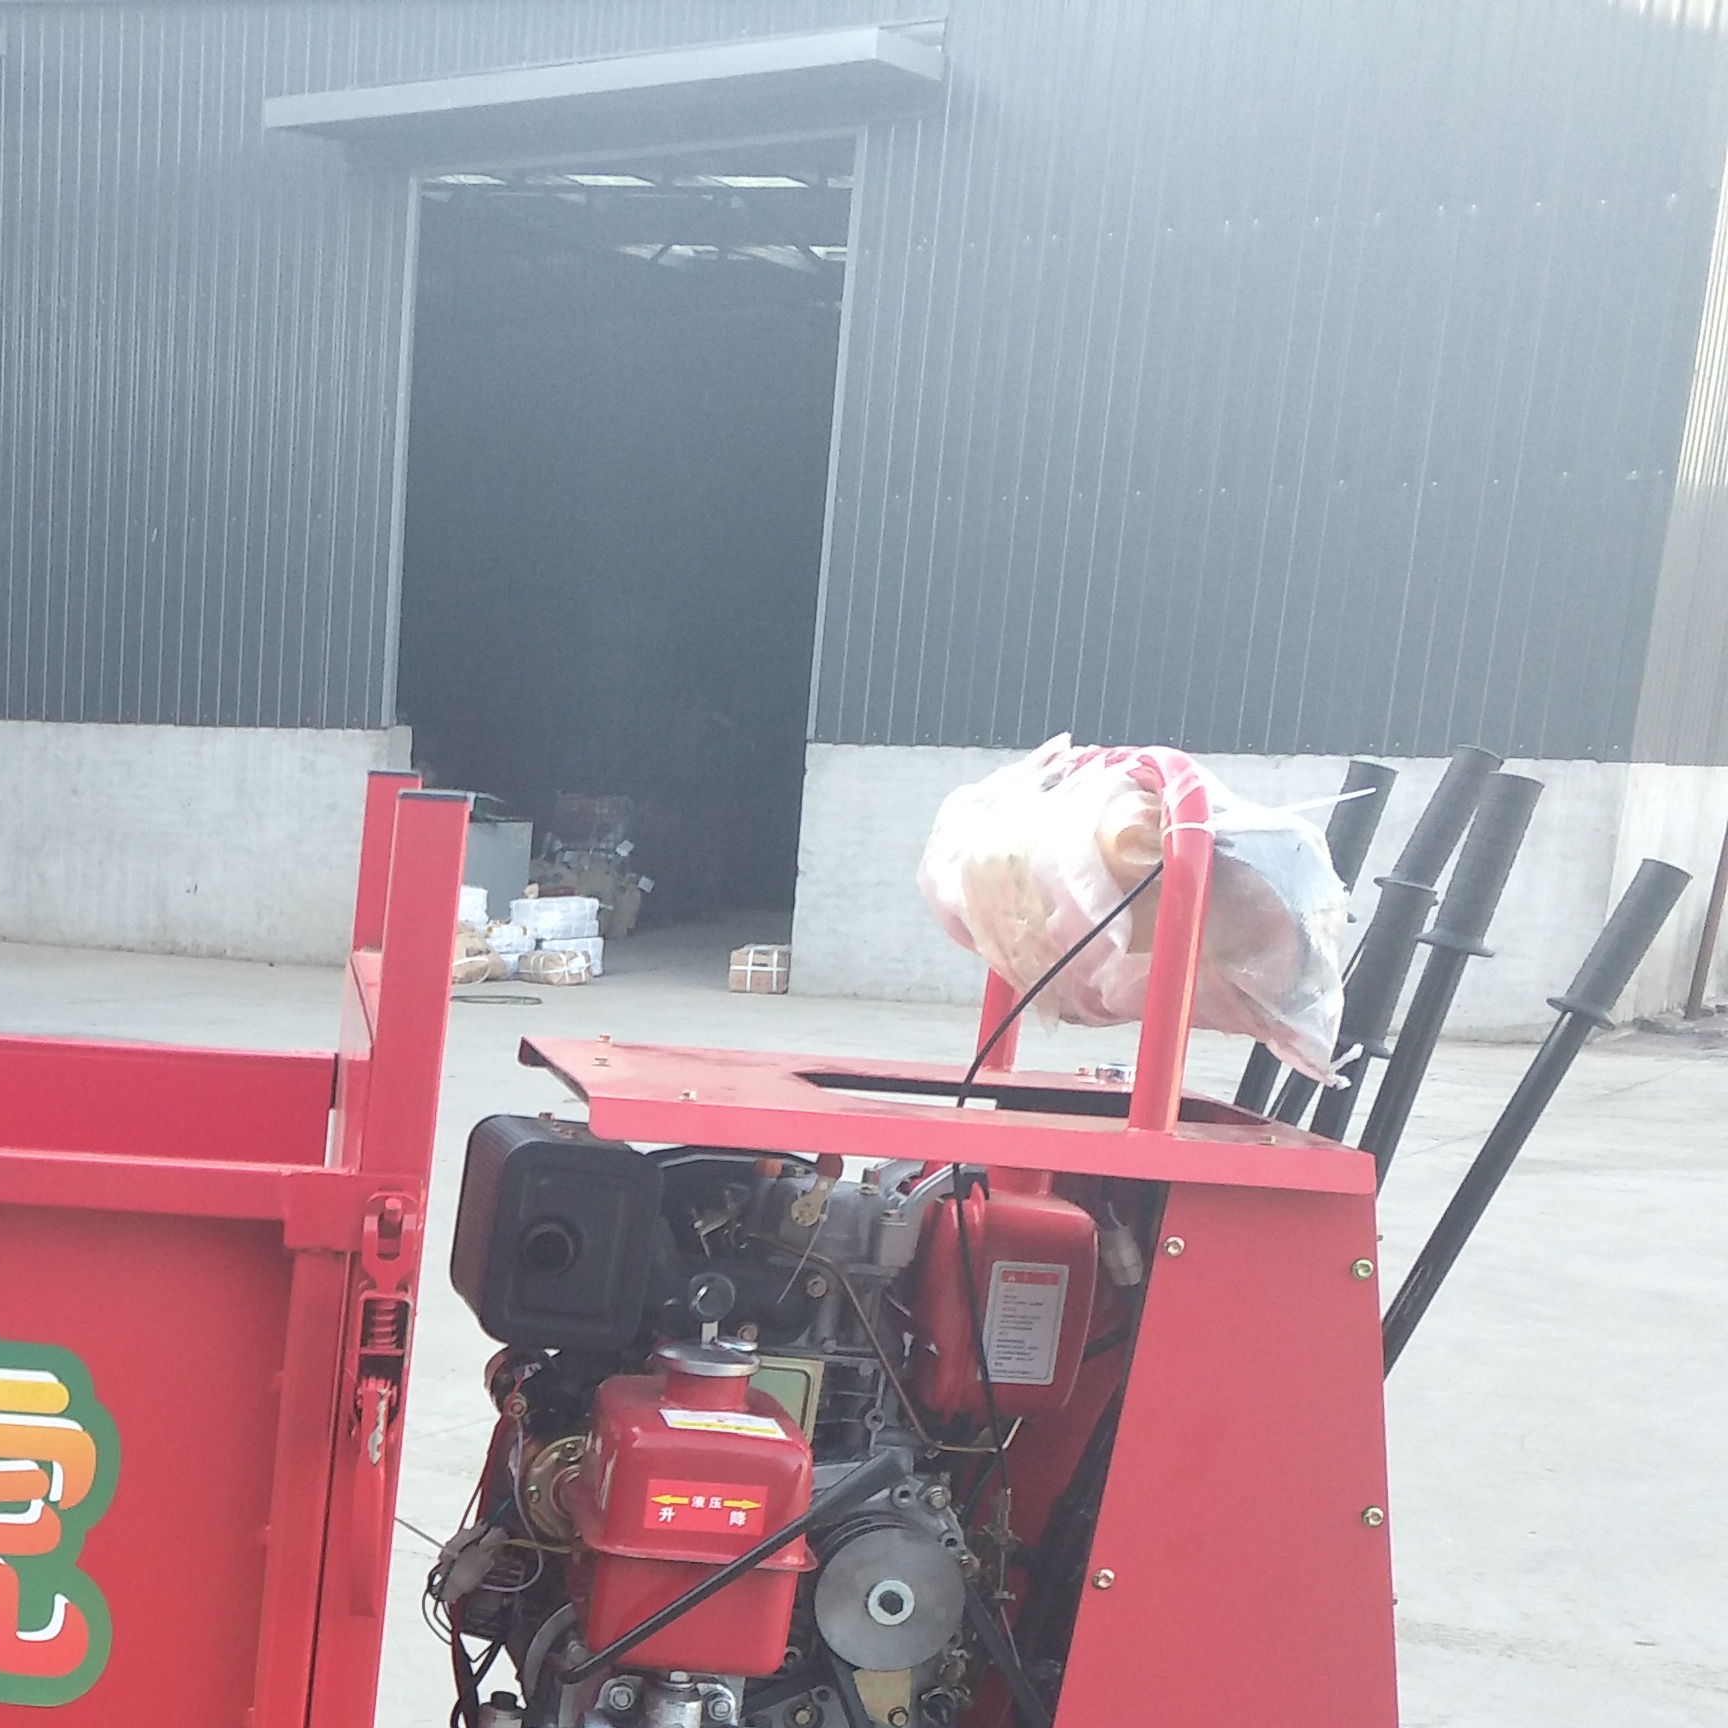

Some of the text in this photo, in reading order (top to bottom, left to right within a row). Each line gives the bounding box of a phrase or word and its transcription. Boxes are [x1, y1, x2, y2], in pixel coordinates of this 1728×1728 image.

[691, 1495, 722, 1510] 液压
[658, 1507, 748, 1527] 升 降
